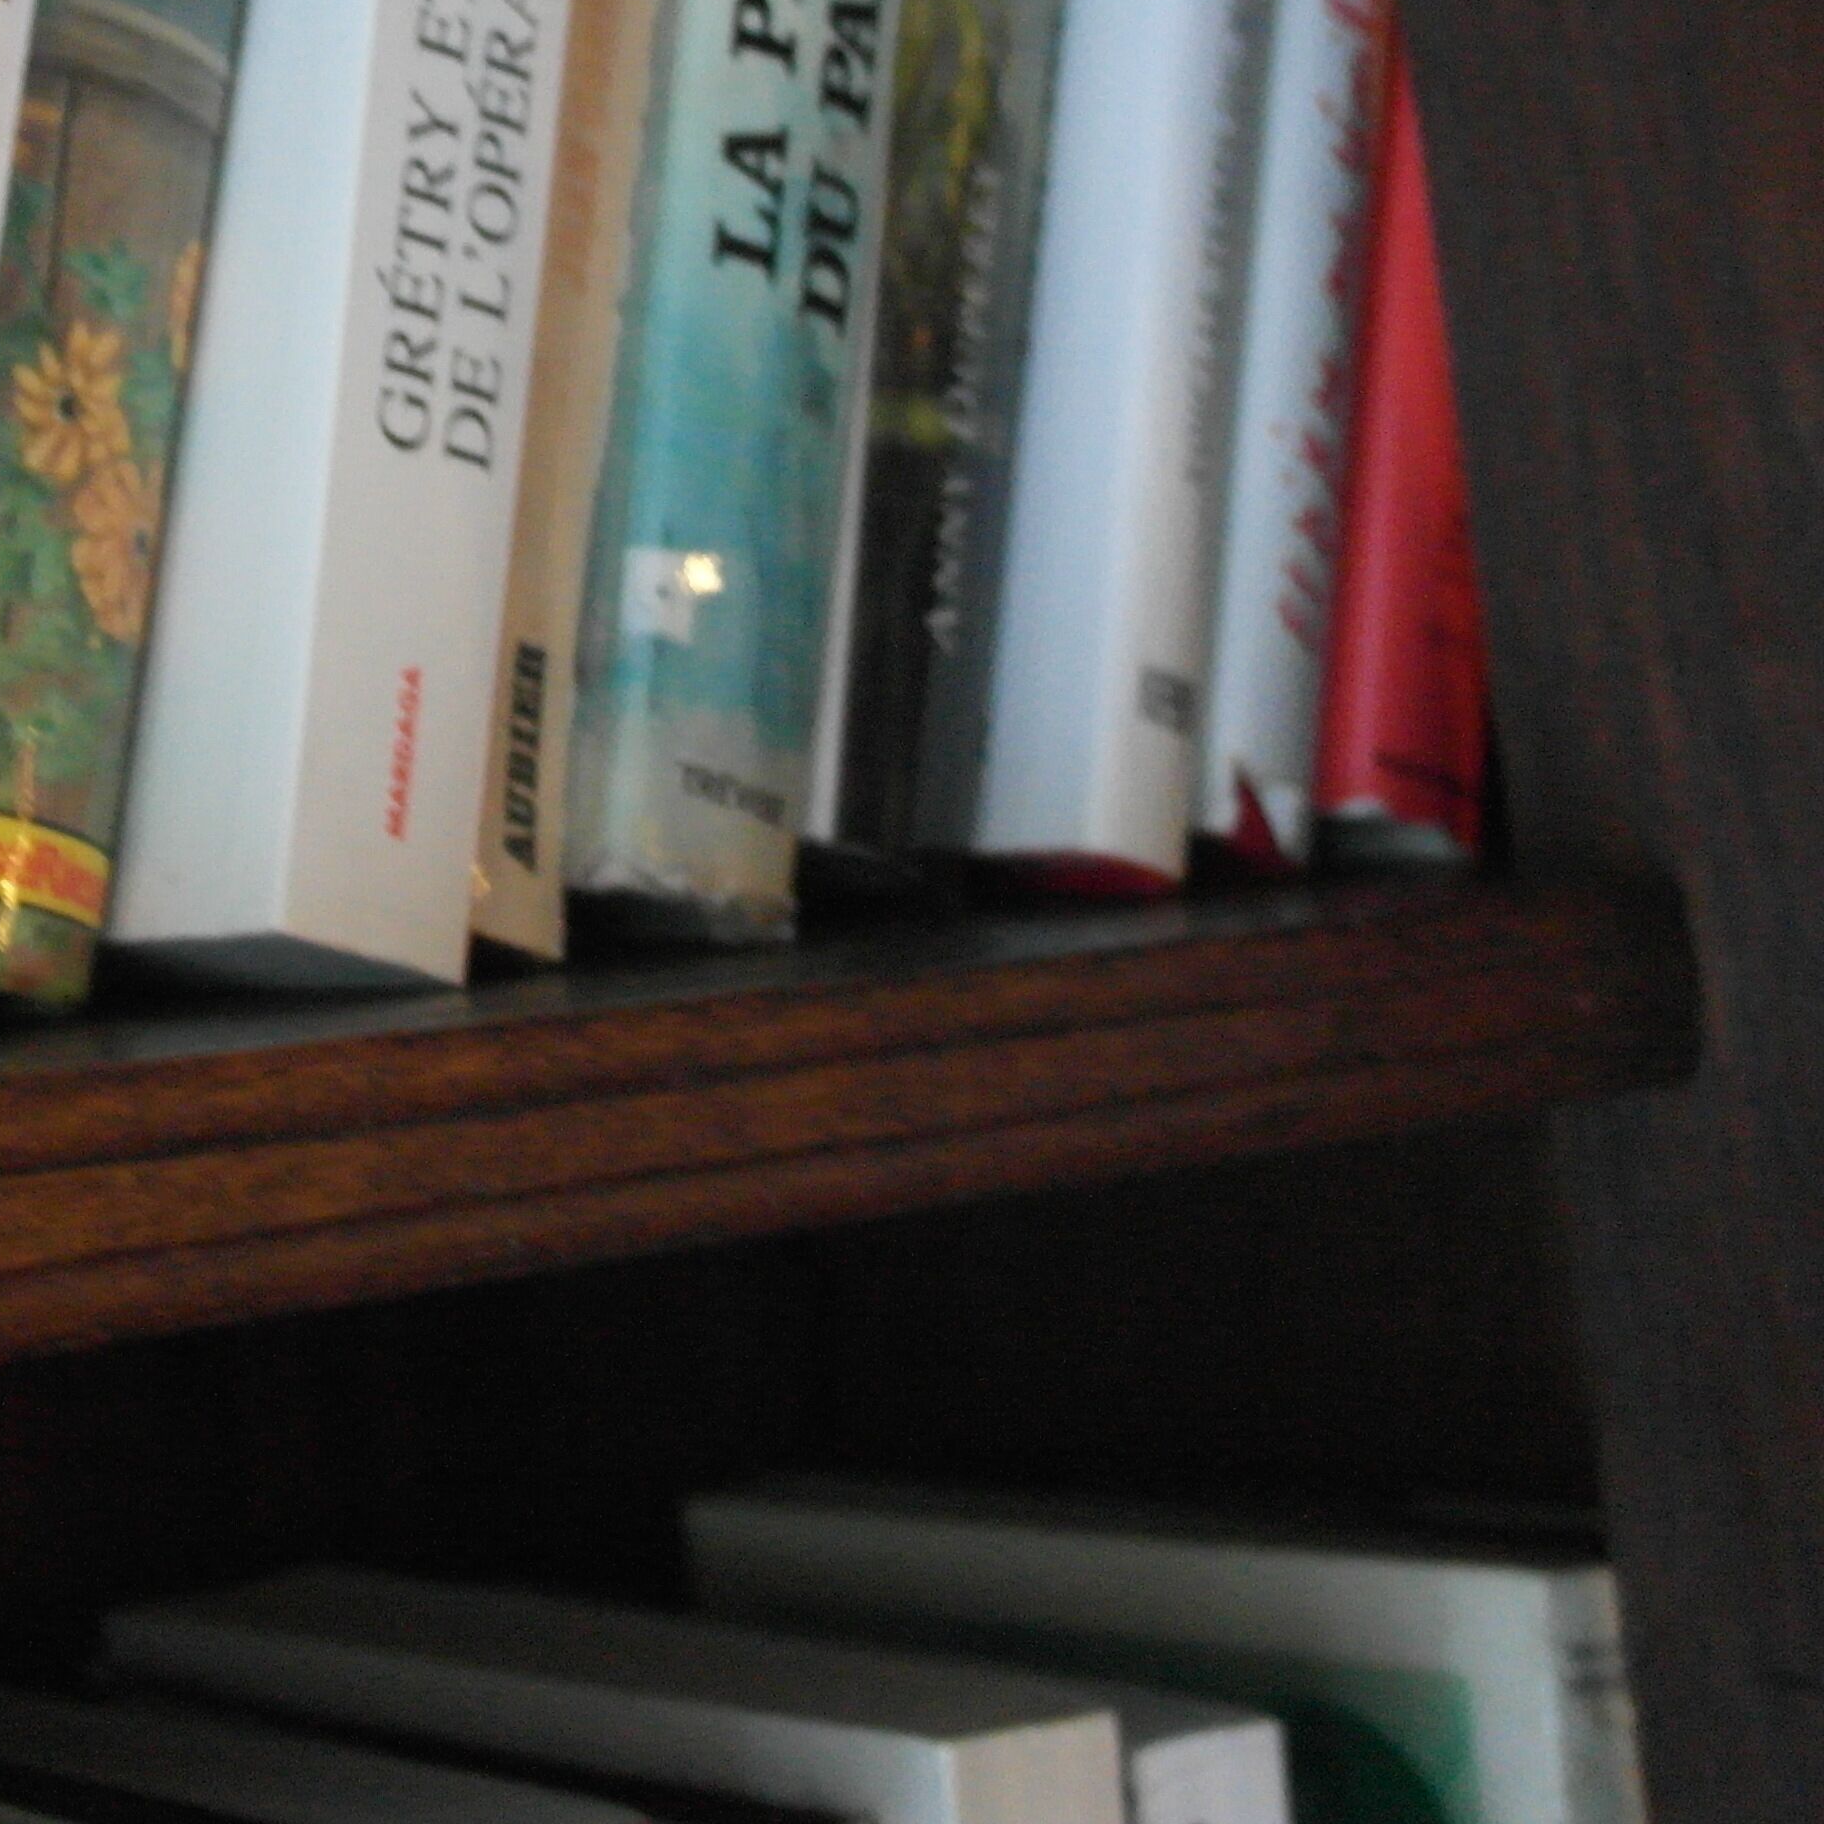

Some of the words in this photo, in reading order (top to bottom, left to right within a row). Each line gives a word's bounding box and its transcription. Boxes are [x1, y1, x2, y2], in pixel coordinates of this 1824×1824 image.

[377, 88, 460, 453] GRÉTRY
[710, 125, 789, 286] LA
[799, 163, 860, 339] DU
[442, 346, 504, 470] DE
